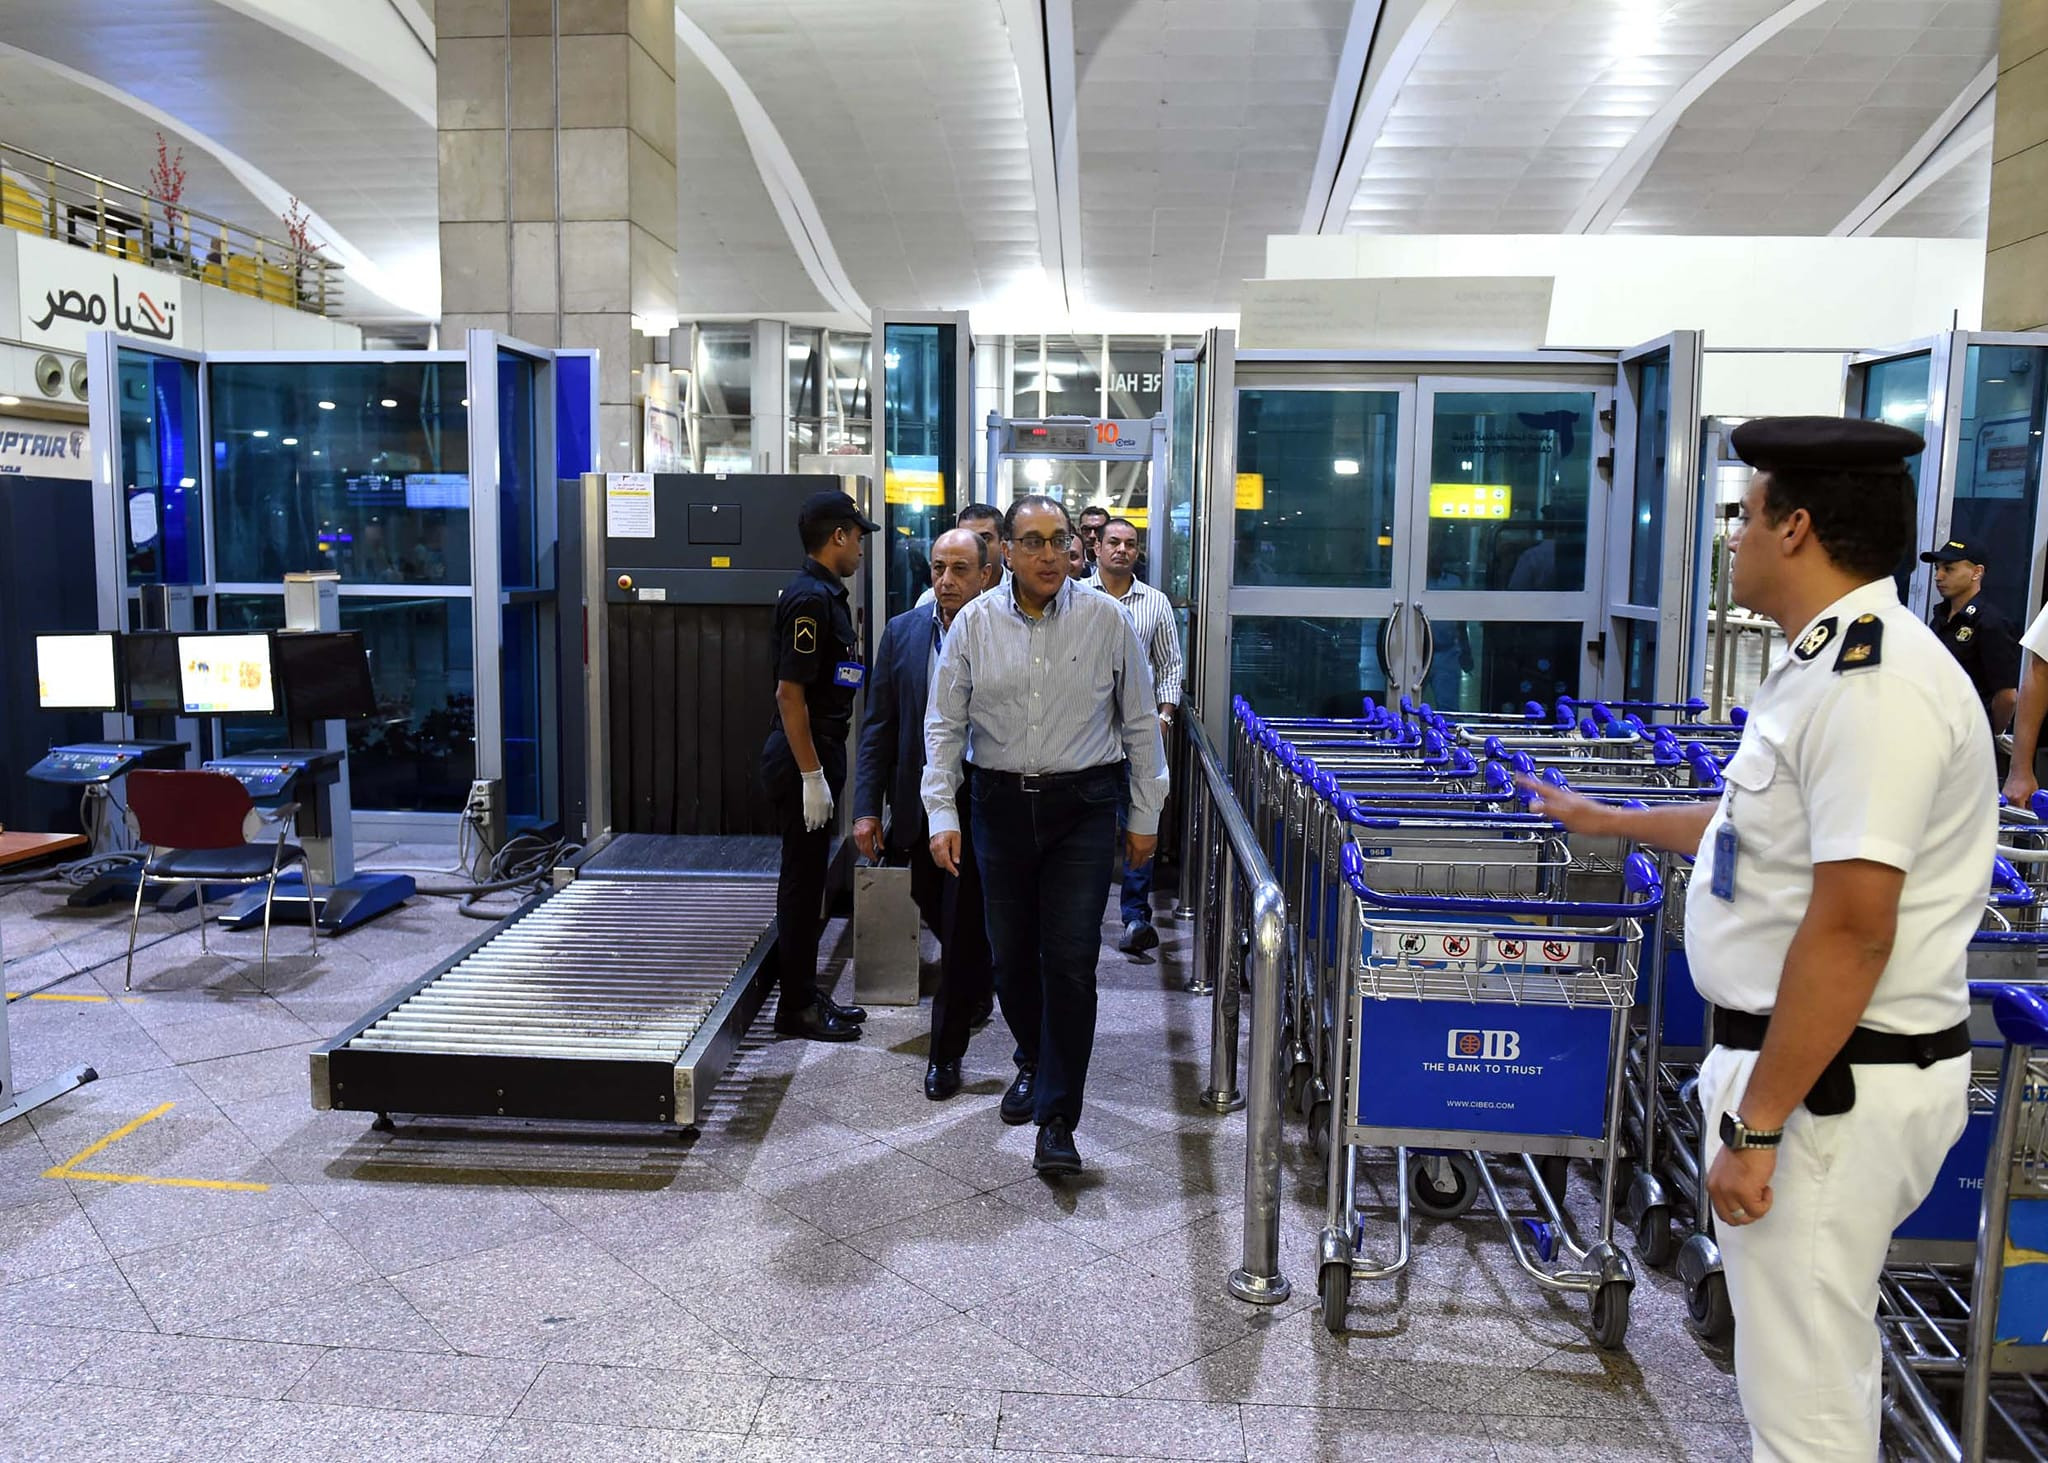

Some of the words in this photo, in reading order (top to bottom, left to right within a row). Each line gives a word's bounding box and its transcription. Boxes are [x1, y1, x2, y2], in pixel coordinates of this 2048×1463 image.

[28, 289, 107, 331] مصر
[1094, 422, 1119, 444] 10
[1447, 1029, 1520, 1060] CIB
[1422, 1062, 1445, 1072] THE
[1448, 1063, 1480, 1073] BANK
[1485, 1064, 1500, 1074] TO
[1504, 1065, 1543, 1075] TRUST
[1446, 1099, 1515, 1109] WWW.CIBEG.COM
[1958, 1177, 1985, 1189] THE
